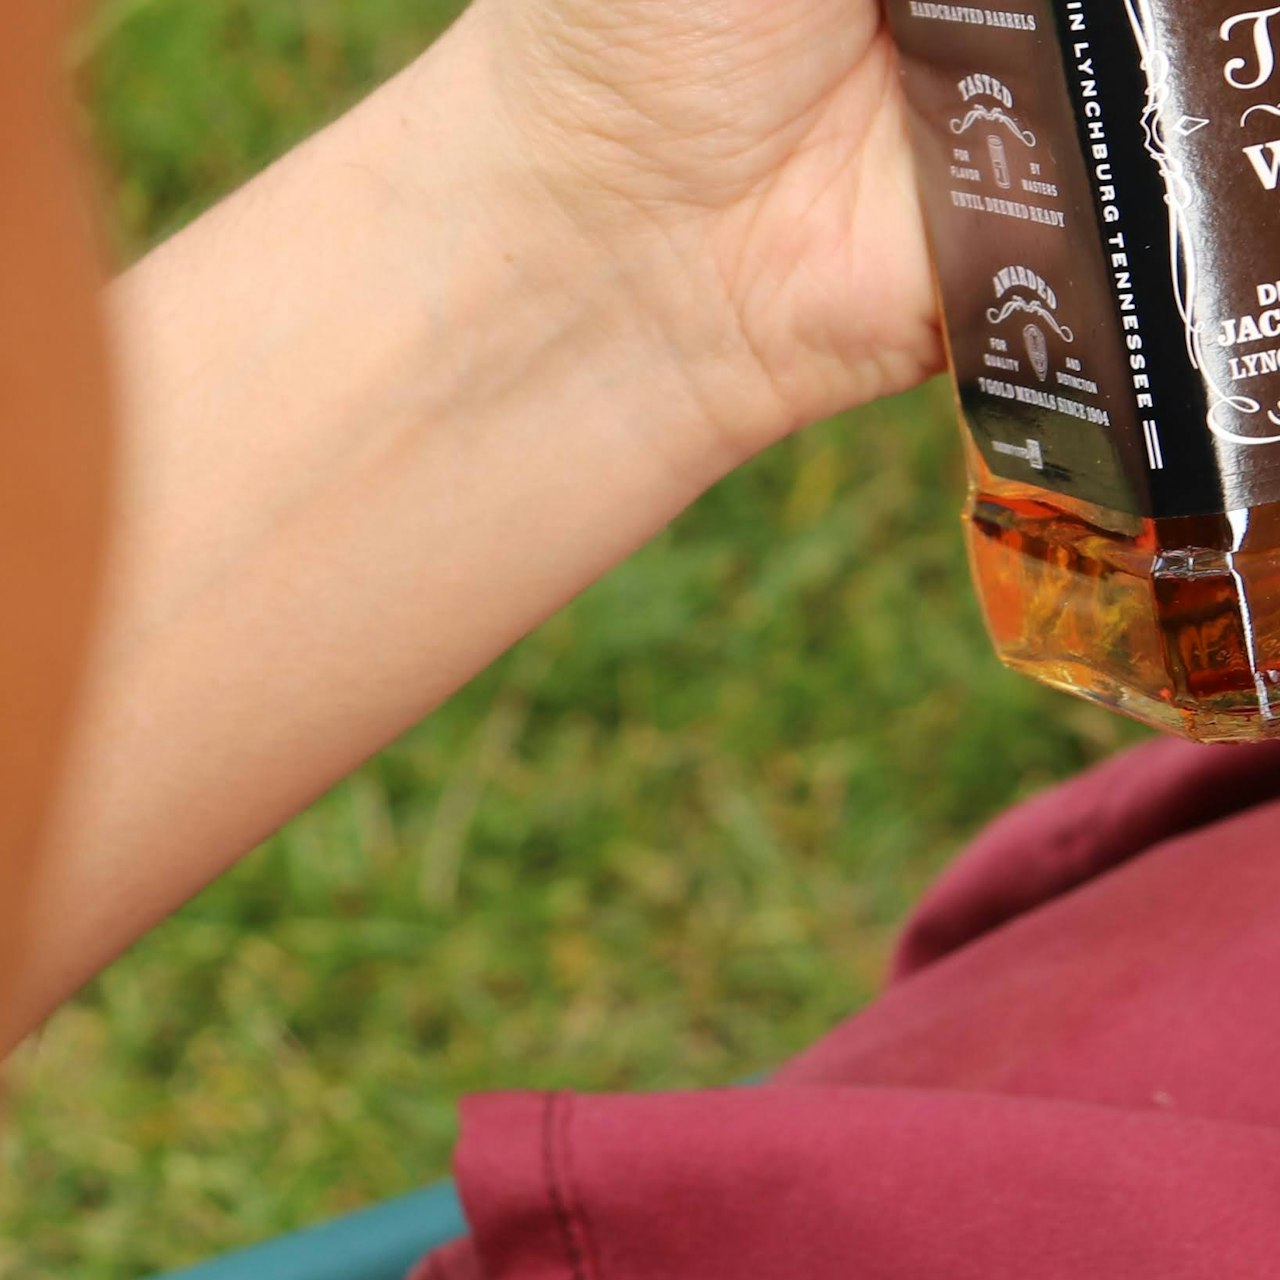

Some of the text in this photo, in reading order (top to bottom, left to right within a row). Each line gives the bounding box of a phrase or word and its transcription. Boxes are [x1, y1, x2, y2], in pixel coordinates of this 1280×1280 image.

[909, 1, 1036, 31] HANDCRAFTED BARRELS
[1067, 1, 1086, 33] IN
[957, 73, 1013, 109] TASTED
[1070, 41, 1120, 223] LYNCHBURG
[953, 148, 970, 162] FOR
[950, 165, 982, 182] FLAVOR
[1029, 162, 1040, 175] BY
[1021, 178, 1058, 197] MASTERS
[950, 190, 1065, 228] UNTIL DEEMED READY
[993, 265, 1057, 310] AWARDED
[1106, 231, 1154, 409] TENNESSEE
[990, 337, 1007, 352] FOR
[984, 353, 1019, 372] QUALITY
[1065, 357, 1081, 371] AND
[1056, 371, 1098, 394] DISTINCTION
[986, 379, 1015, 399] GOLD
[1015, 385, 1057, 411] MEDALS
[1056, 397, 1087, 419] SINCE
[1085, 406, 1111, 427] 1904
